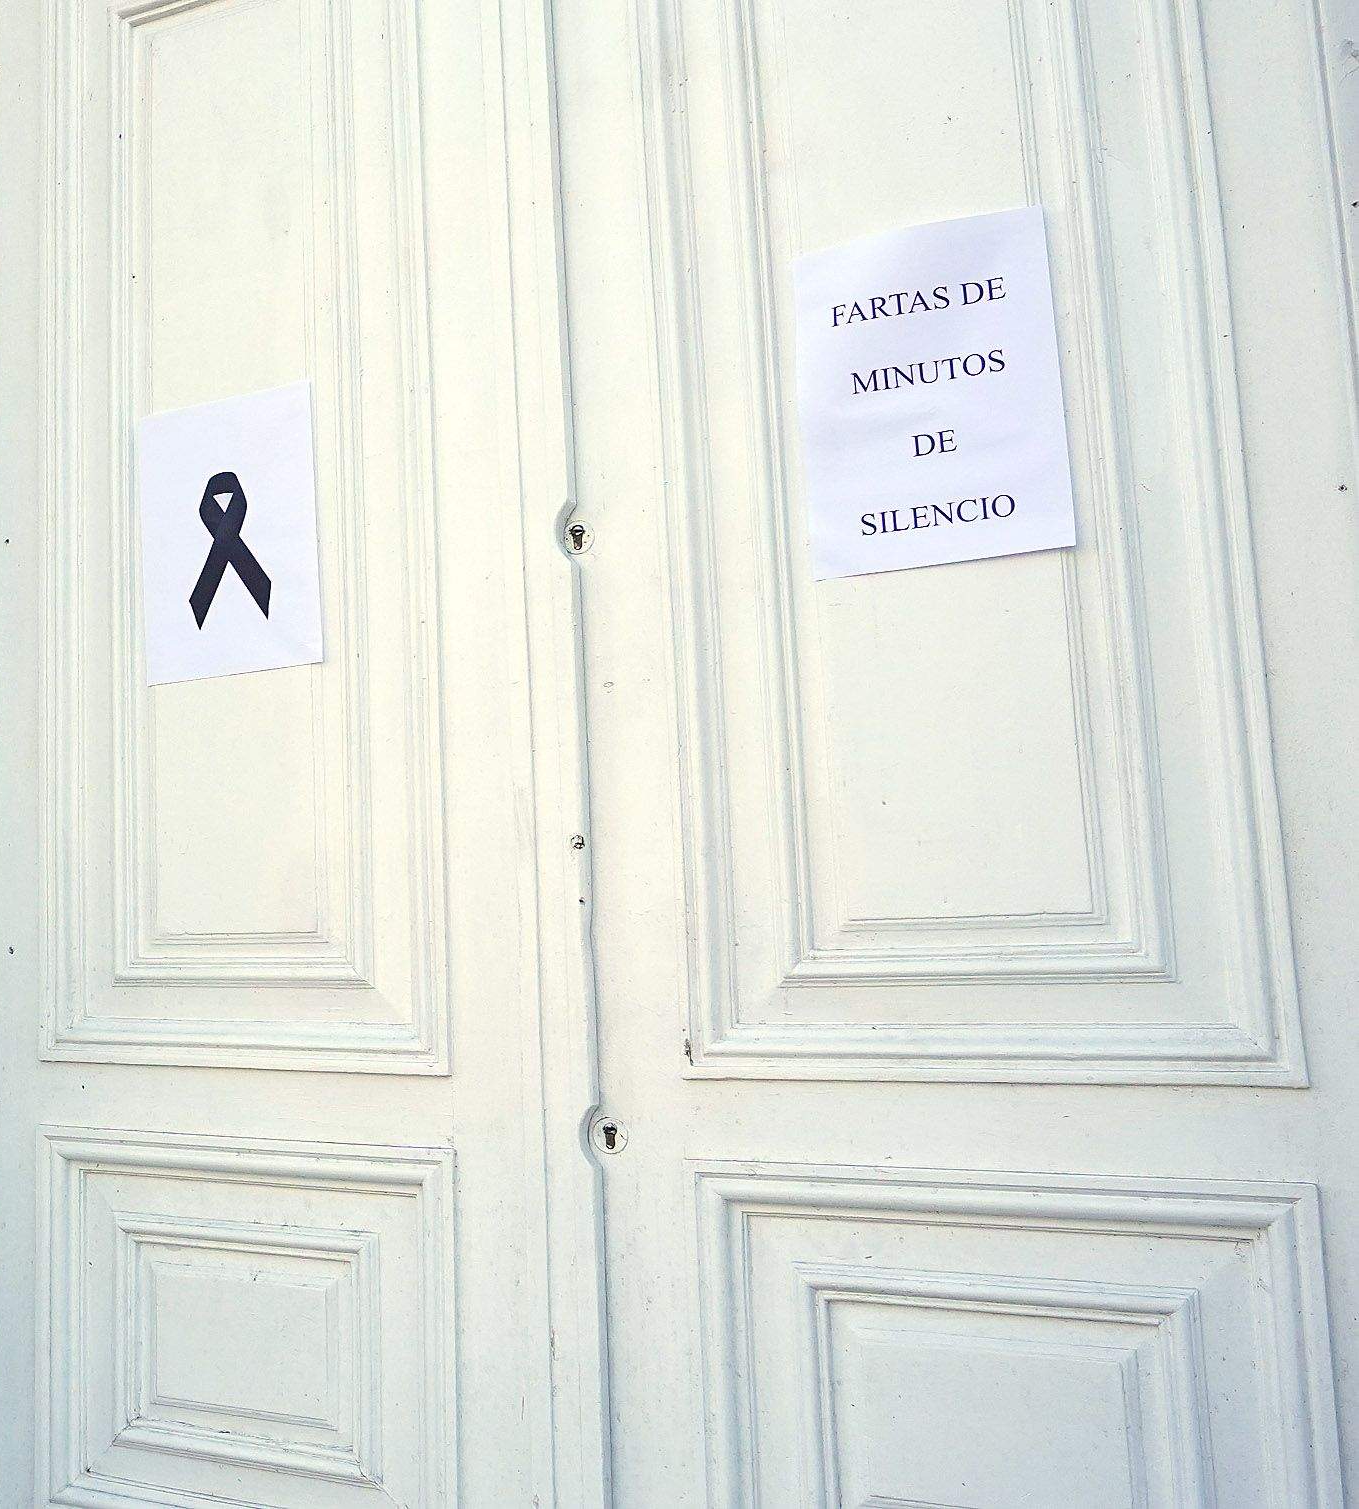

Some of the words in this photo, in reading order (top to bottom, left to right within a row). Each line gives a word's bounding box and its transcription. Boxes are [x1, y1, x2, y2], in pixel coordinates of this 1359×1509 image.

[831, 285, 951, 328] FARTAS
[959, 276, 1007, 307] DE
[850, 348, 1006, 396] MINUTOS
[911, 429, 959, 458] DE
[860, 493, 1017, 537] SILENCIO
